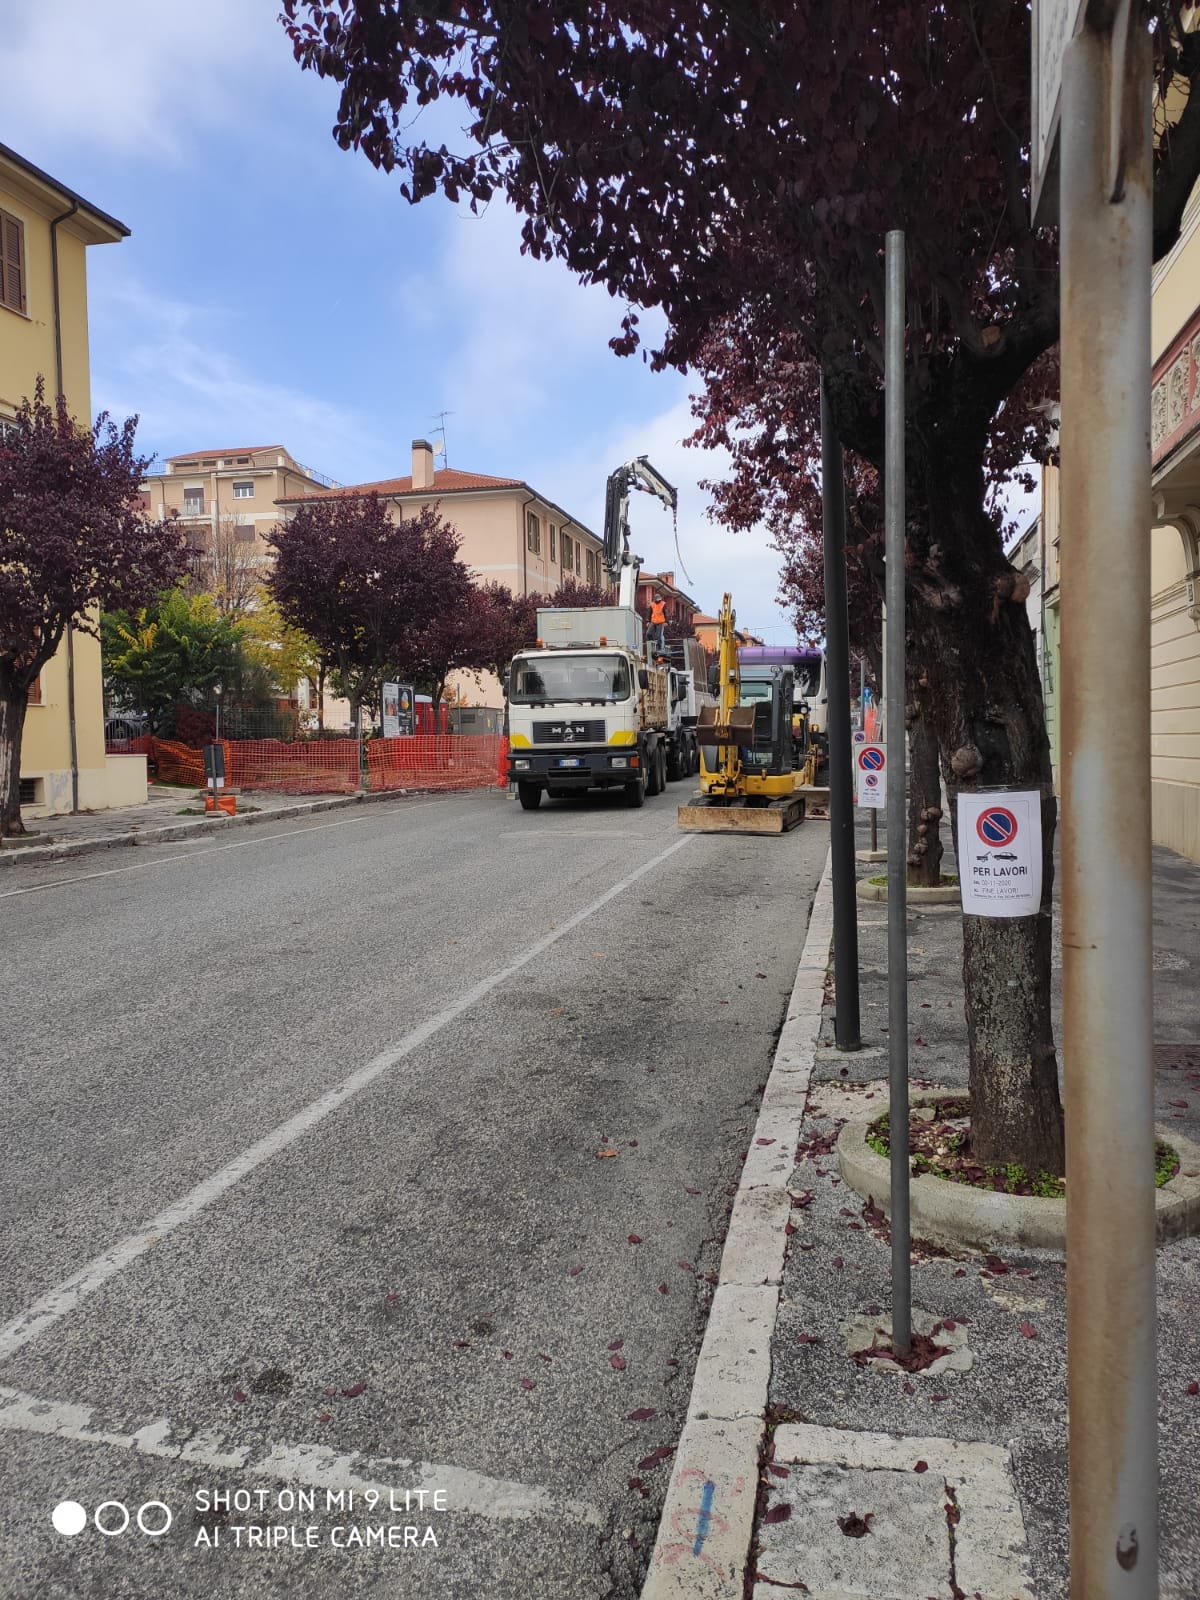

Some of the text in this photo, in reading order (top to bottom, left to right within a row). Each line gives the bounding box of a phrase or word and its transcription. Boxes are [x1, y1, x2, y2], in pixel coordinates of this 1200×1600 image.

[552, 726, 585, 734] MAN
[973, 866, 1028, 877] PER LAVORI
